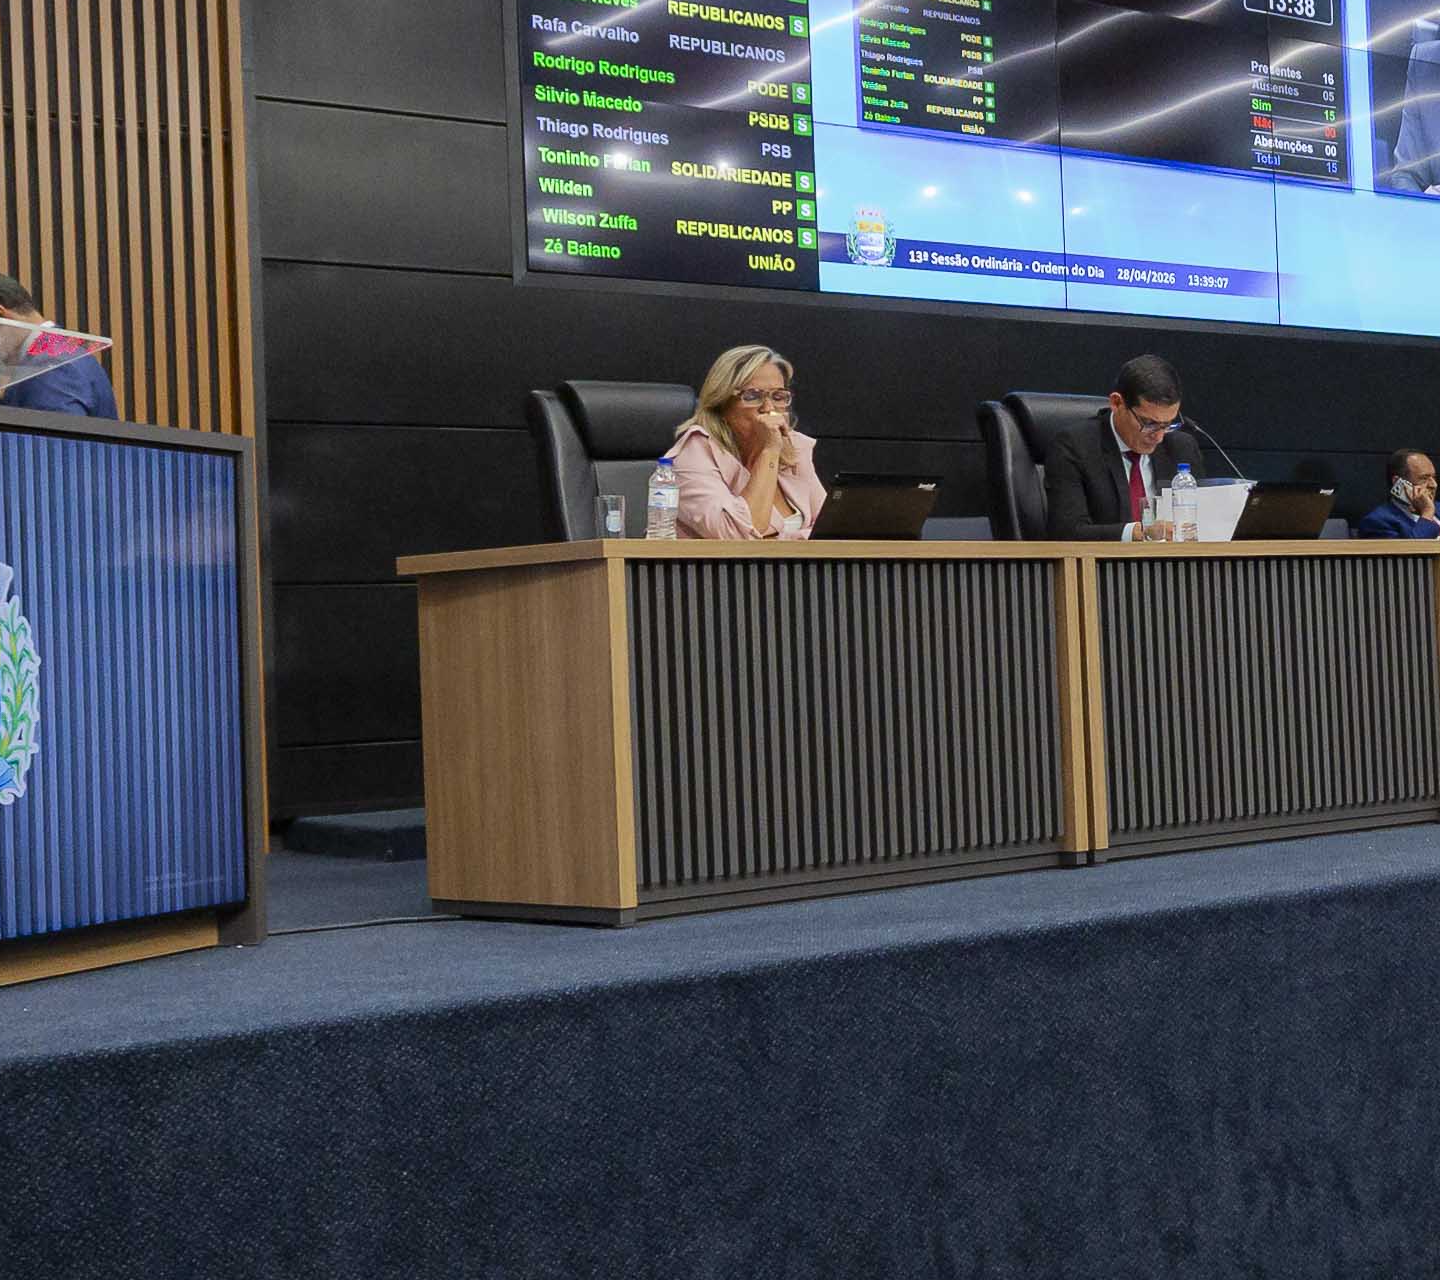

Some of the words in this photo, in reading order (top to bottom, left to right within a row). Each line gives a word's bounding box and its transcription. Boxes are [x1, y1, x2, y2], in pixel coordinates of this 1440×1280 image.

[667, 0, 784, 30] REPUBLICANOS
[793, 19, 803, 33] S
[531, 14, 566, 33] Rafa
[571, 20, 639, 43] Carvalho
[669, 33, 785, 64] REPUBLICANOS
[533, 50, 595, 75] Rodrigo
[598, 60, 675, 84] Rodrigues
[534, 84, 579, 105] Silvio
[582, 90, 642, 112] Macedo
[747, 79, 788, 98] PODE
[796, 86, 805, 100] S
[1251, 97, 1271, 112] Sim
[536, 115, 588, 138] Thiago
[592, 122, 669, 145] Rodrigues
[748, 110, 789, 130] PSDB
[797, 117, 807, 132] S
[537, 146, 600, 167] Toninho
[761, 142, 791, 158] PSB
[671, 160, 791, 187] SOLIDARIEDADE
[799, 174, 809, 189] S
[538, 176, 592, 197] Wilden
[542, 207, 595, 226] Wilson
[598, 212, 637, 230] Zuffa
[772, 199, 792, 215] PP
[800, 202, 810, 216] S
[676, 219, 793, 244] REPUBLICANOS
[802, 231, 812, 245] S
[543, 237, 563, 254] Zé
[567, 240, 620, 258] Baiano
[748, 253, 795, 271] UNIÃO
[930, 251, 969, 267] Sessão
[971, 255, 1022, 271] Ordinária
[1031, 259, 1069, 275] Ordem
[1071, 263, 1085, 276] do
[1087, 265, 1104, 278] Dia
[1116, 267, 1175, 284] 28/04/2026
[1187, 274, 1228, 288] 13:39:07
